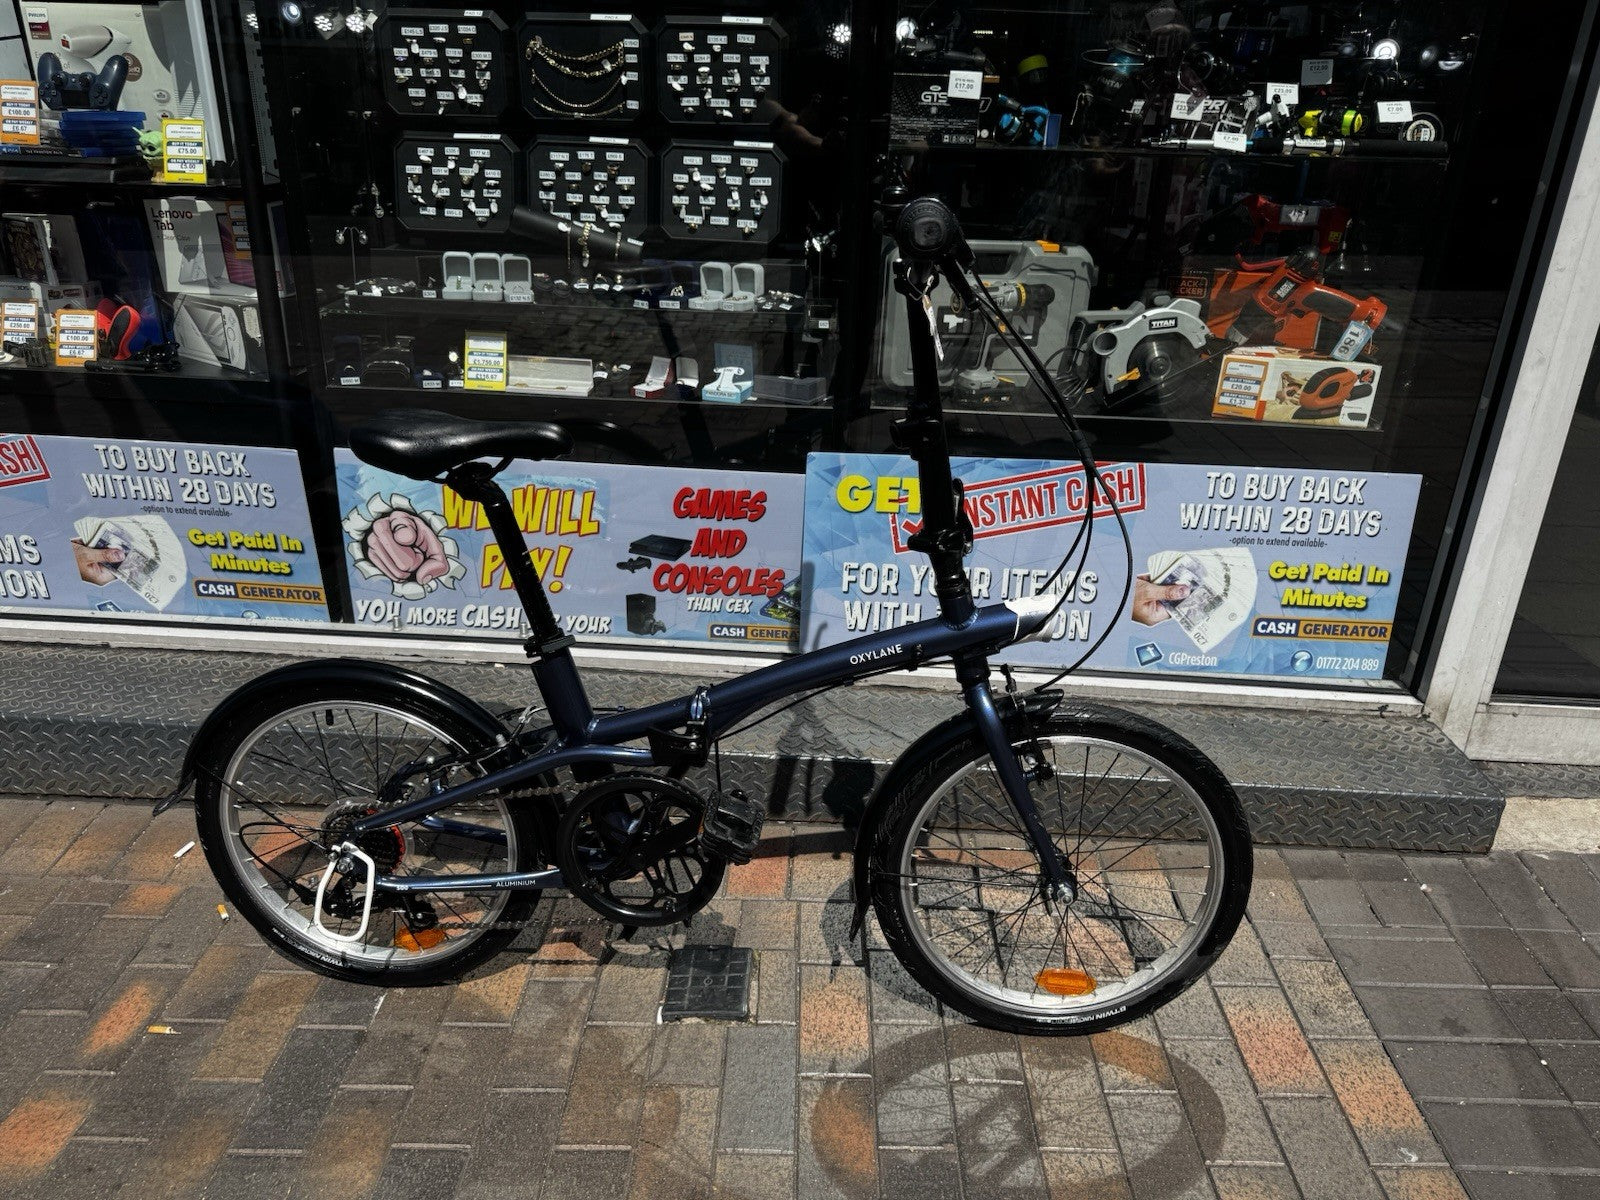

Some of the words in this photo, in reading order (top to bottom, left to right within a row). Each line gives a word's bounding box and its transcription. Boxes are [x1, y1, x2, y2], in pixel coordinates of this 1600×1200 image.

[921, 91, 949, 103] GTS
[151, 207, 193, 219] Lenovo
[154, 220, 174, 231] Tab
[1151, 318, 1176, 328] TITAN
[94, 444, 126, 470] TO
[131, 446, 177, 473] BUY
[184, 449, 251, 477] BACK
[82, 472, 173, 502] WITHIN
[179, 477, 212, 504] 28
[214, 479, 277, 507] DAYS
[835, 474, 922, 514] GET
[963, 481, 1059, 529] NSTANT
[1065, 467, 1134, 512] CASH
[1206, 471, 1236, 500] TO
[1243, 473, 1295, 501] BUY
[1298, 475, 1367, 505] BACK
[174, 507, 198, 516] extend
[512, 484, 600, 537] WILL
[673, 487, 768, 522] GAMES
[1179, 502, 1272, 532] WITHIN
[1279, 506, 1312, 534] 28
[1317, 508, 1382, 537] DAYS
[187, 528, 225, 548] Get
[229, 530, 277, 550] Paid
[281, 536, 304, 552] In
[691, 528, 747, 559] AND
[1256, 537, 1264, 546] to
[1266, 537, 1290, 547] extend
[210, 553, 293, 575] Minutes
[481, 542, 574, 594] PY!
[1269, 560, 1309, 581] Get
[1312, 563, 1363, 583] Paid
[1366, 566, 1390, 585] In
[198, 581, 236, 597] CASH
[241, 586, 323, 601] GENERATOR
[653, 562, 787, 597] CONSOLES
[841, 561, 900, 595] FOR
[1001, 567, 1099, 602] ITEMS
[686, 597, 726, 612] THAN
[1281, 588, 1368, 610] Minutes
[356, 599, 402, 622] YOU
[407, 606, 458, 625] MORE
[461, 604, 521, 629] CASH
[565, 614, 611, 634] YOUR
[843, 599, 922, 632] WITH
[712, 627, 745, 637] CASH
[750, 628, 799, 639] GENERA
[1257, 620, 1297, 636] CASH
[1303, 622, 1388, 638] GENERATOR
[849, 643, 904, 666] OXYLANE
[1168, 652, 1218, 667] CGPreston
[1316, 656, 1341, 670] 01772
[1342, 657, 1360, 671] 204
[1361, 658, 1379, 671] 889
[495, 879, 536, 888] ALUMINIUM
